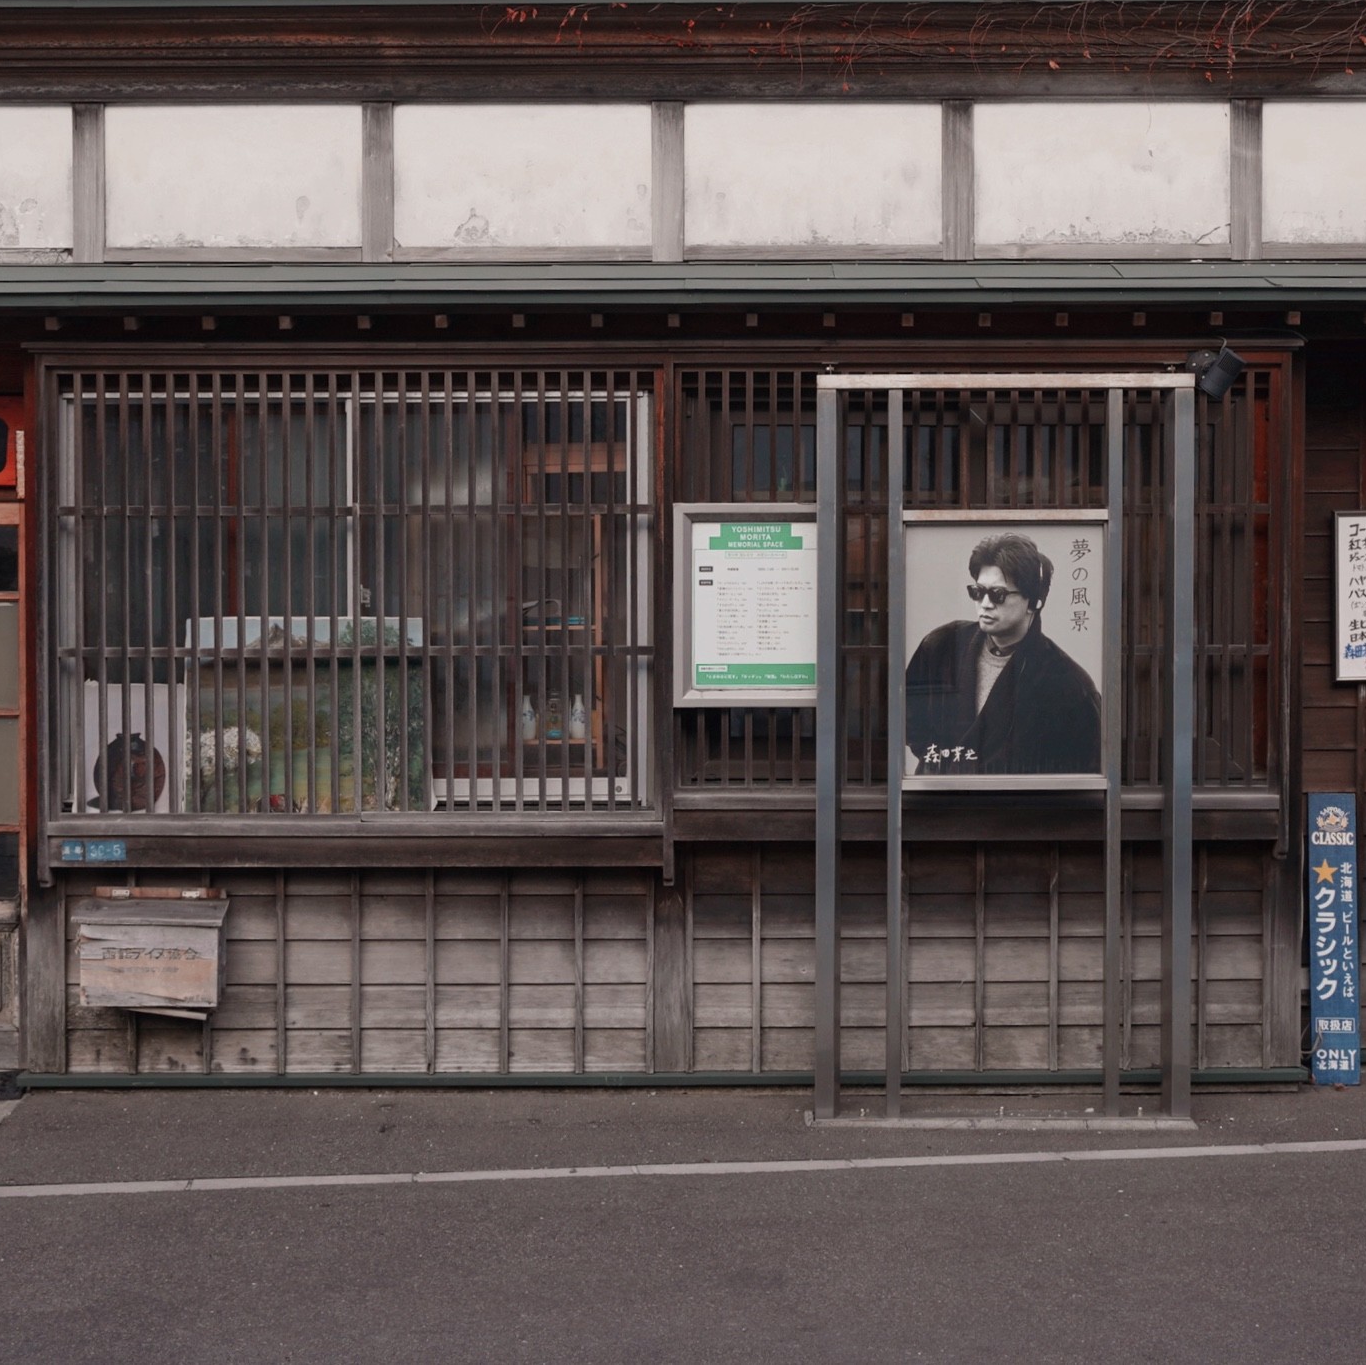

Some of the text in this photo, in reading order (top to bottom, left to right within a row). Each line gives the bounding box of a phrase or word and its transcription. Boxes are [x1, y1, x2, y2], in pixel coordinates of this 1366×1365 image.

[1070, 539, 1091, 632] 夢の風景
[1311, 831, 1354, 845] CLASSIC
[1315, 887, 1338, 1000] クラシック
[1318, 1020, 1352, 1031] 取扱店
